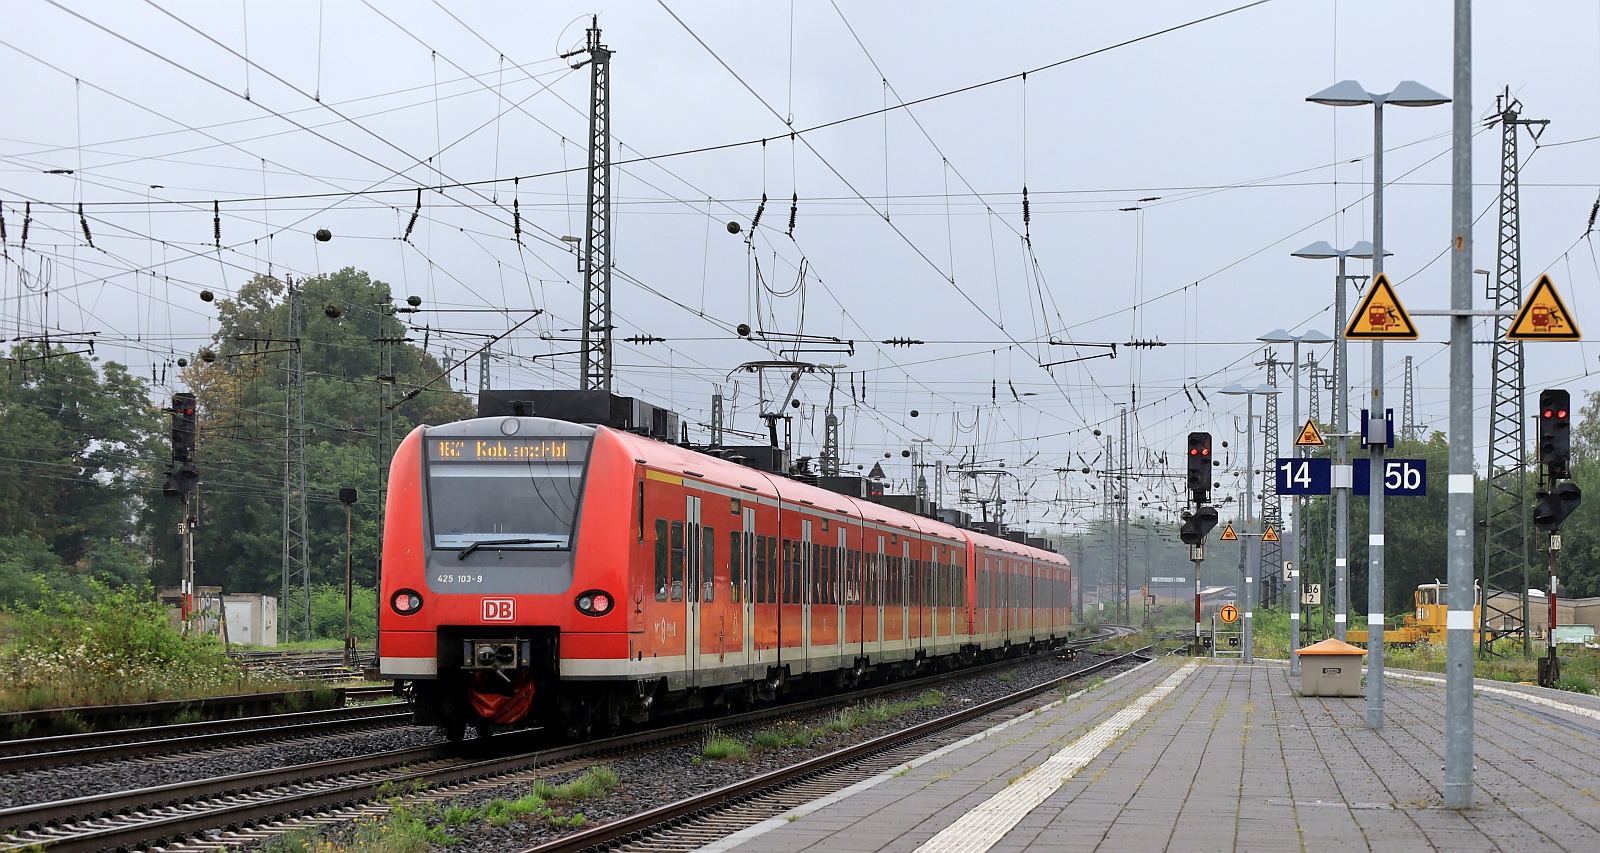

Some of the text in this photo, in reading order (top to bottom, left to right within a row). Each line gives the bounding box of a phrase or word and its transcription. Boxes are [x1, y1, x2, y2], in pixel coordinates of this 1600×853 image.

[476, 441, 540, 457] Kobenz
[1280, 461, 1312, 489] 14
[1384, 462, 1421, 490] 5b
[437, 574, 483, 583] 425 103-9
[485, 601, 512, 619] DB
